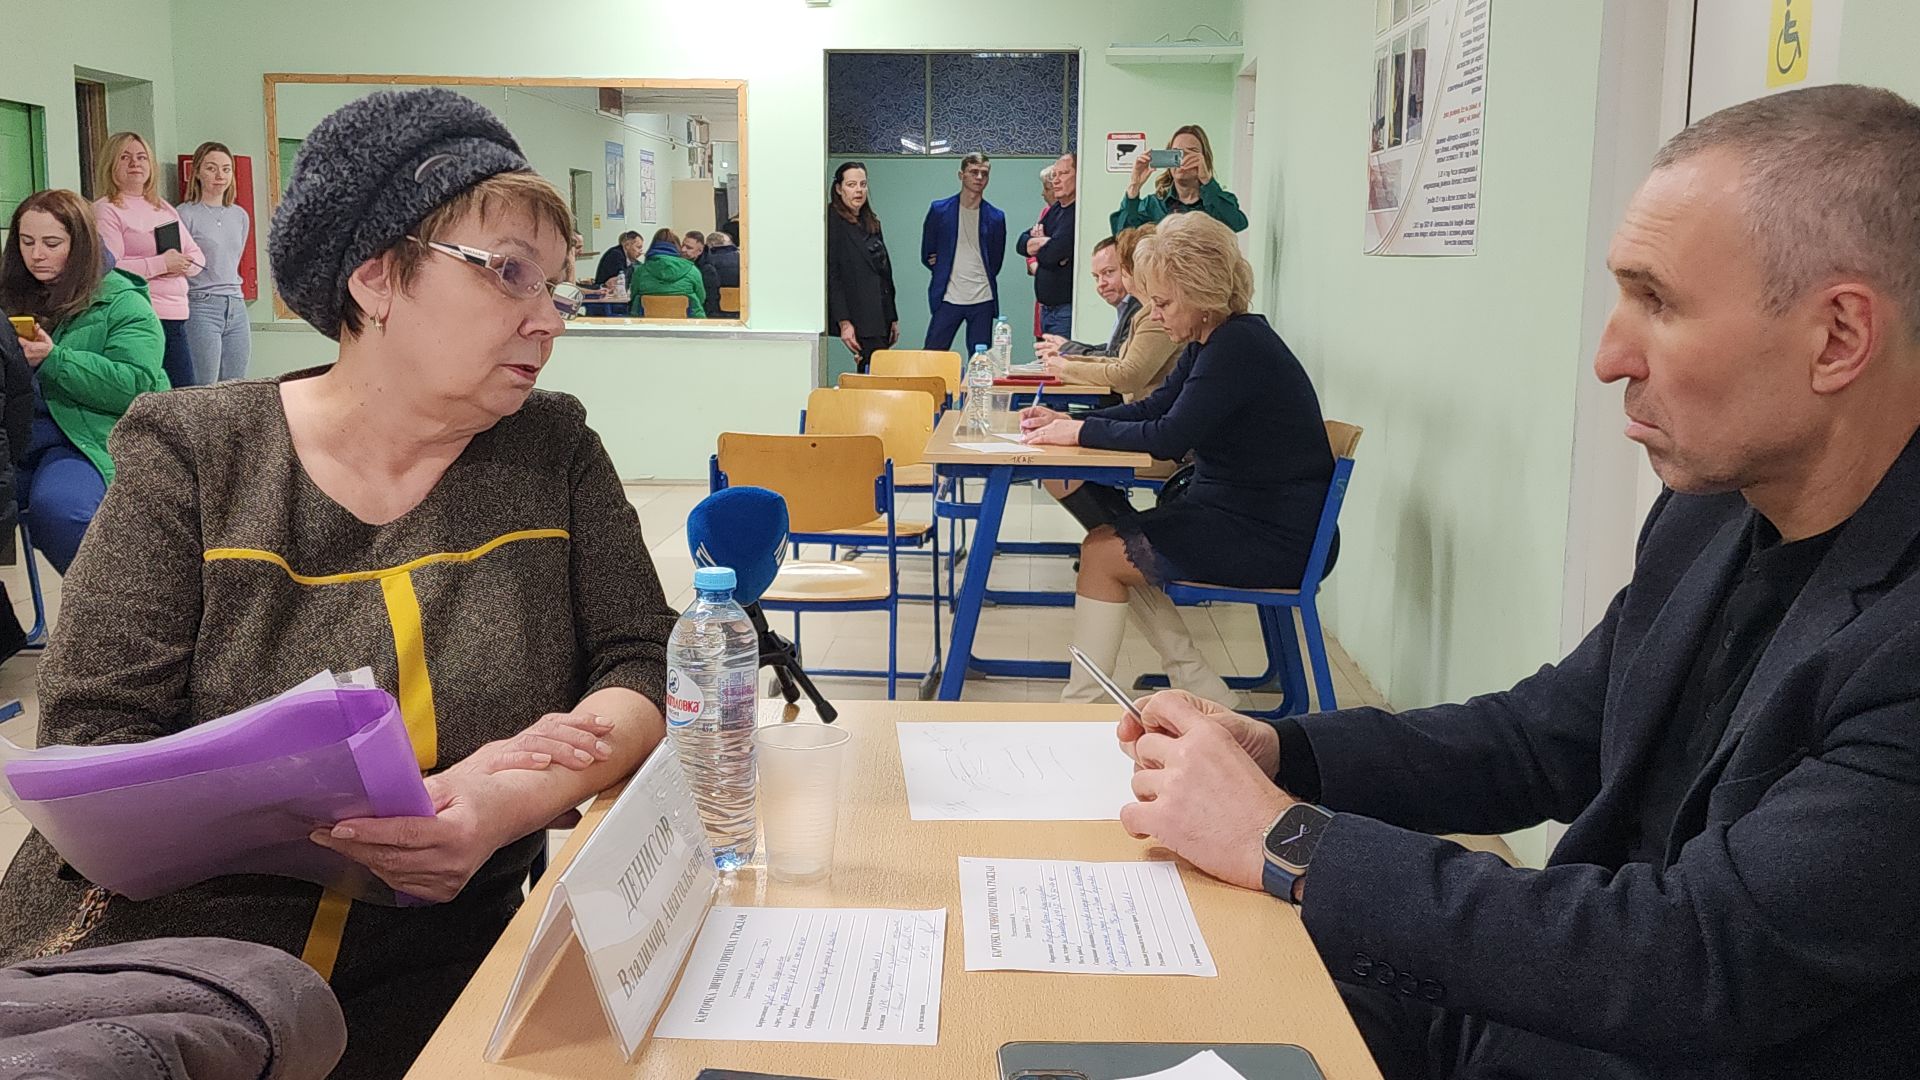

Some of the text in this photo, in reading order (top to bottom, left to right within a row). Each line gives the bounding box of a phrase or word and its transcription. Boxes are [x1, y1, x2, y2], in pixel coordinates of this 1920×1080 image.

[617, 815, 675, 924] ДЕНИСОВ
[617, 844, 705, 1000] Владимир Анатольевич
